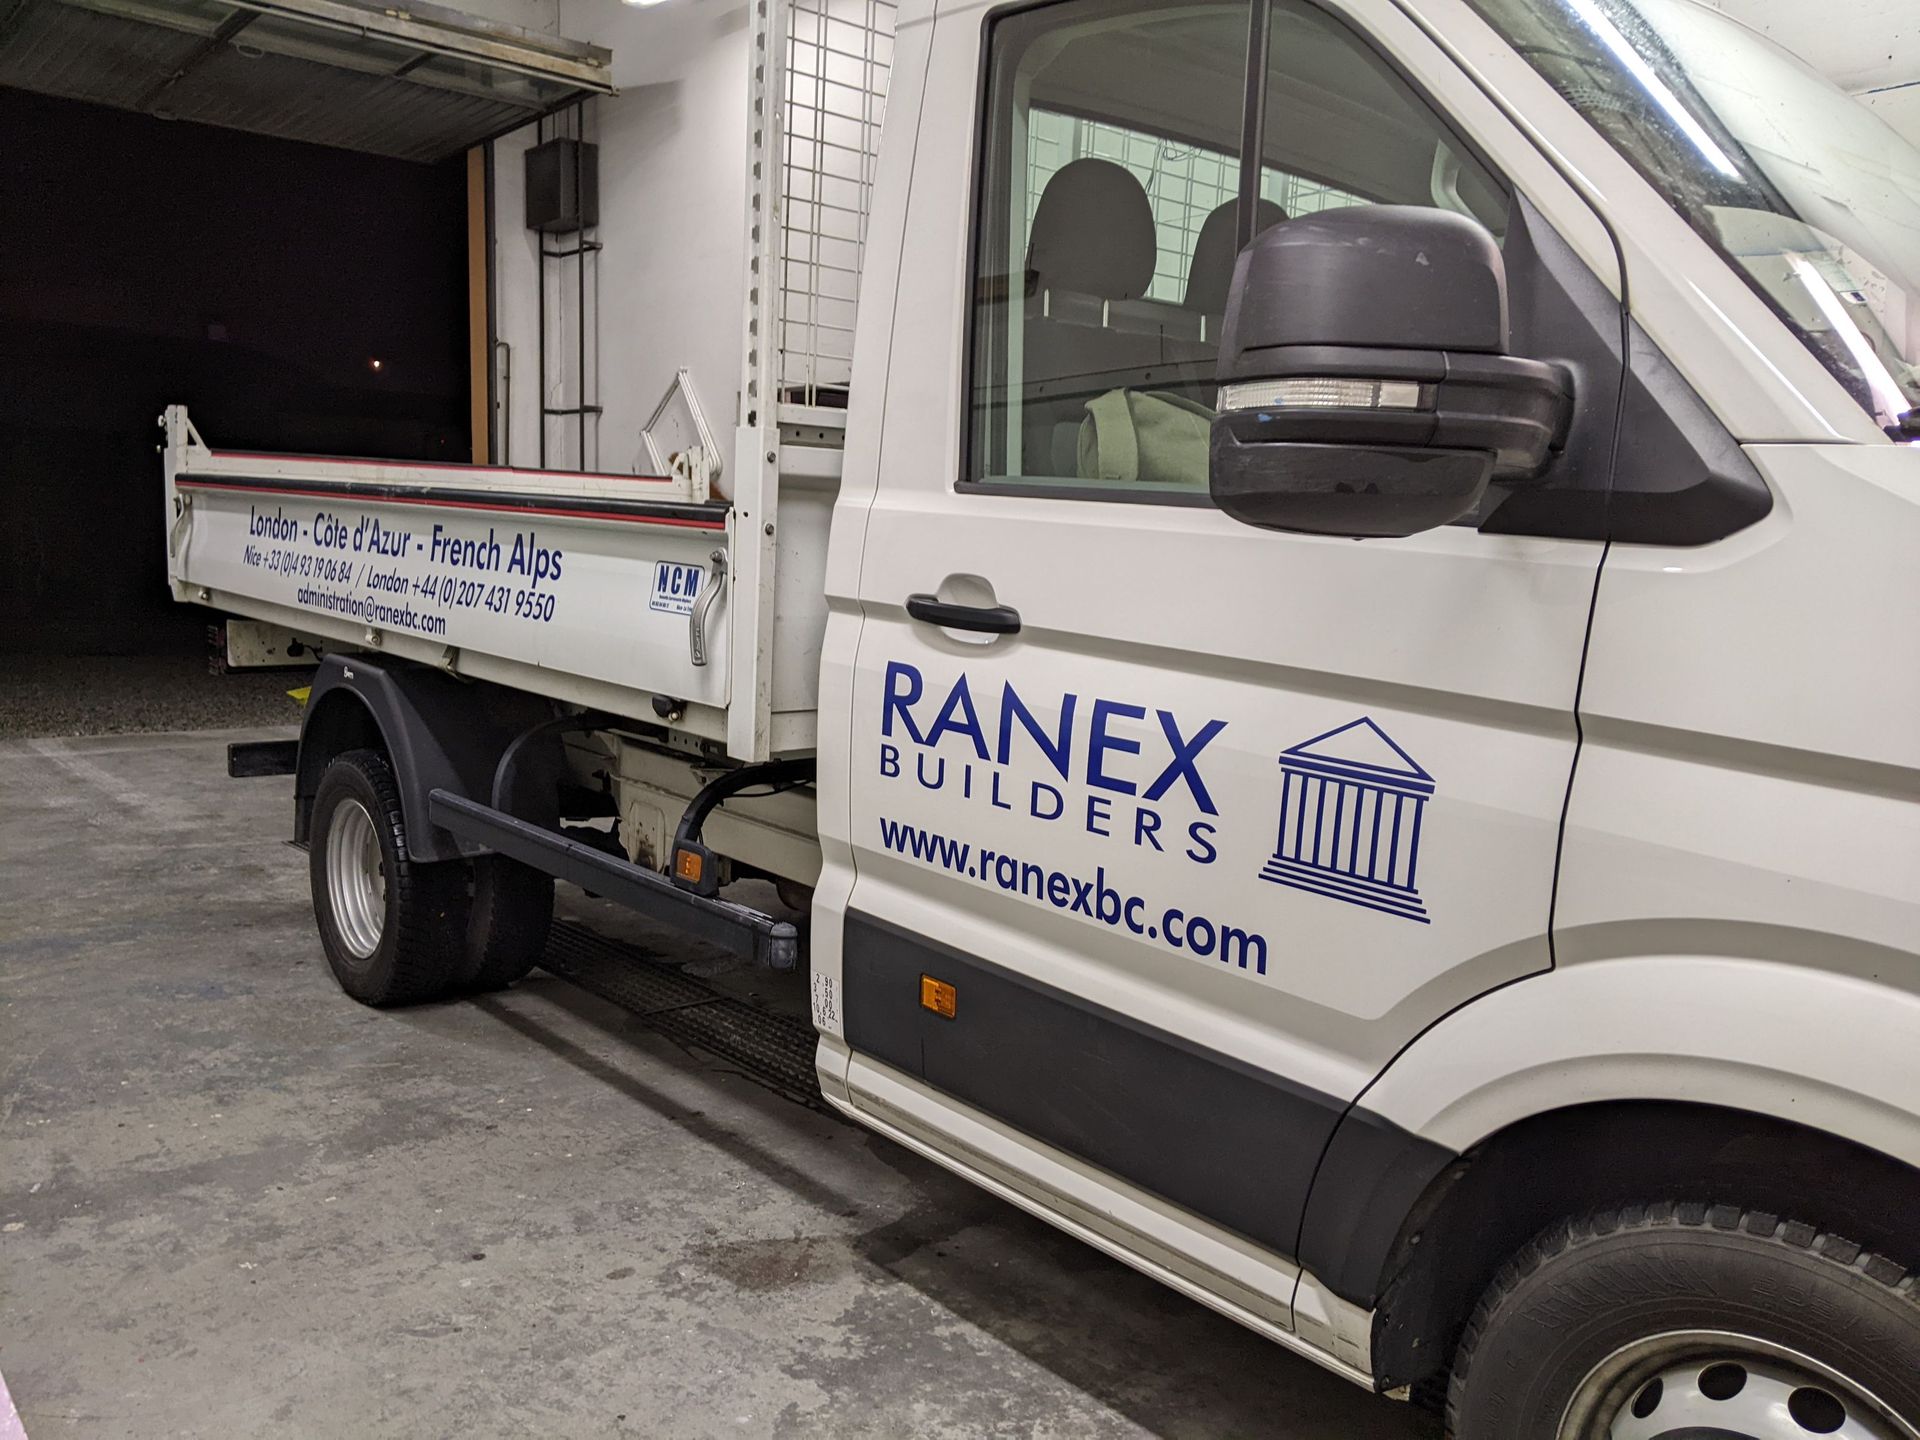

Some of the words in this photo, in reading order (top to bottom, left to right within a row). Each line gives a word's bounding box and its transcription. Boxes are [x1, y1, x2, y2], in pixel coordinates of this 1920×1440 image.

[243, 544, 262, 567] Nice
[366, 565, 409, 595] London
[484, 585, 511, 614] 431
[514, 589, 556, 622] 9550
[250, 505, 298, 542] London
[314, 512, 348, 550] Côte
[430, 524, 501, 571] French
[507, 532, 563, 589] Alps
[297, 582, 446, 636] administration@ranexbc.com
[881, 660, 1230, 816] RANEX
[879, 743, 1218, 864] BUILDERS
[880, 816, 1267, 976] www.ranexbc.com
